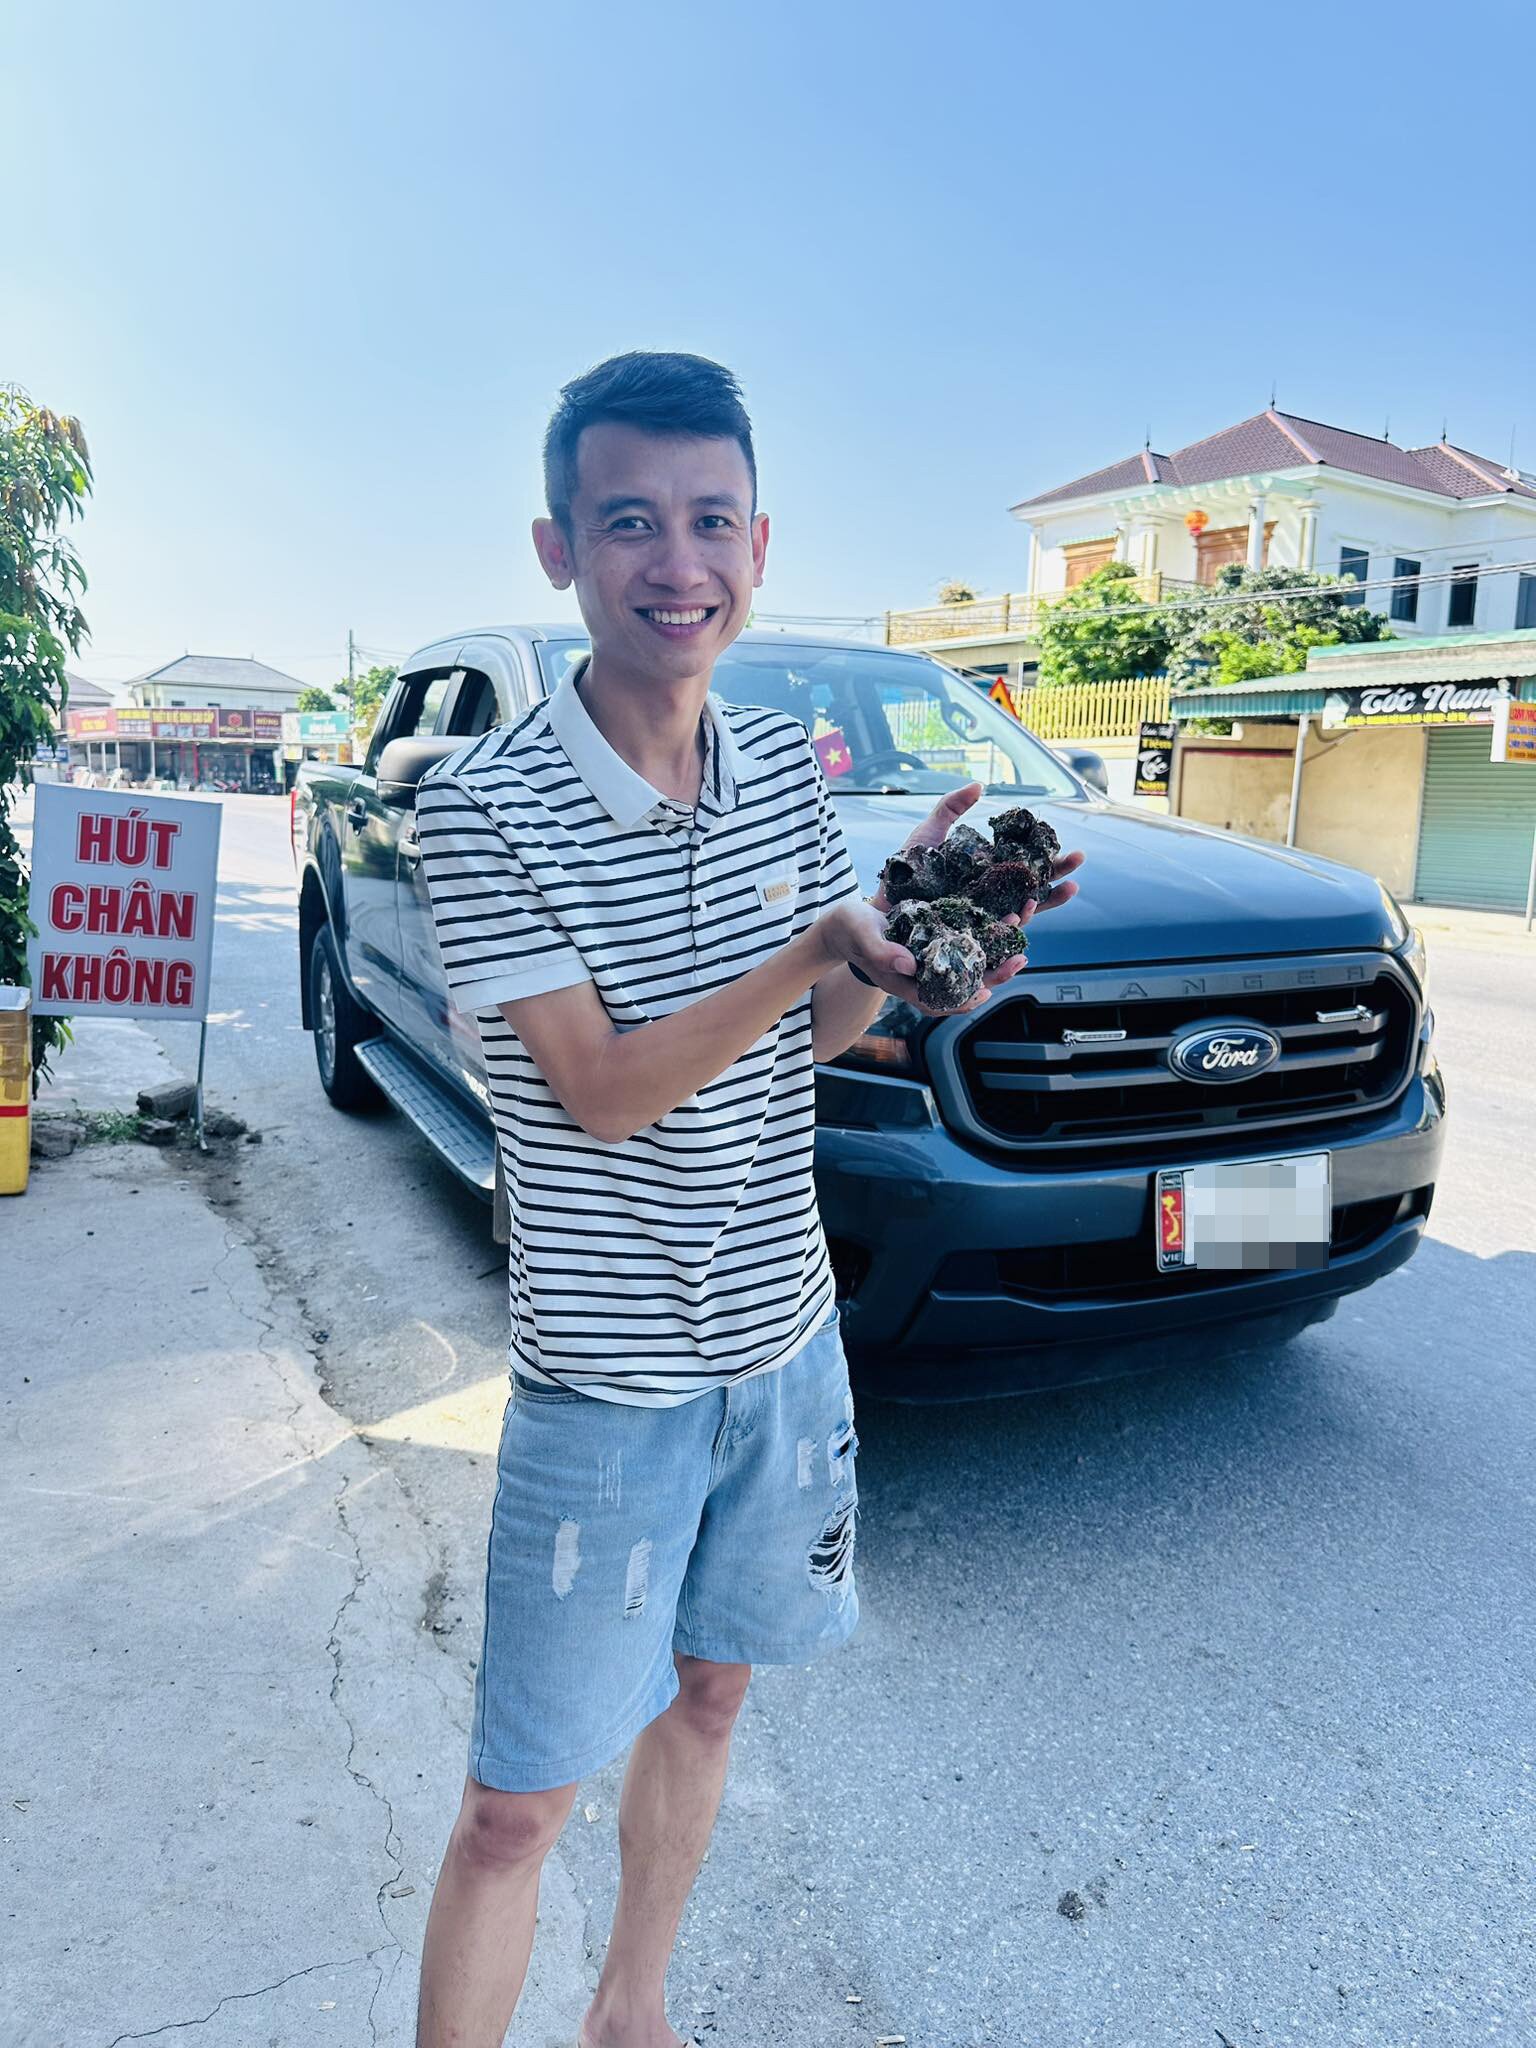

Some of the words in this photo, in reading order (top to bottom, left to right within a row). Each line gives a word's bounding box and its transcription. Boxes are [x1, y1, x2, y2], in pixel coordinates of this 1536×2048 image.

[1360, 686, 1417, 715] Tóc
[1422, 684, 1494, 713] Nam
[76, 808, 182, 870] HÚT
[48, 879, 198, 941] CHÂN
[40, 947, 197, 1008] KHÔNG
[1055, 965, 1365, 1001] RANGER
[1202, 1037, 1259, 1071] Ford
[1161, 1252, 1181, 1263] VIE
